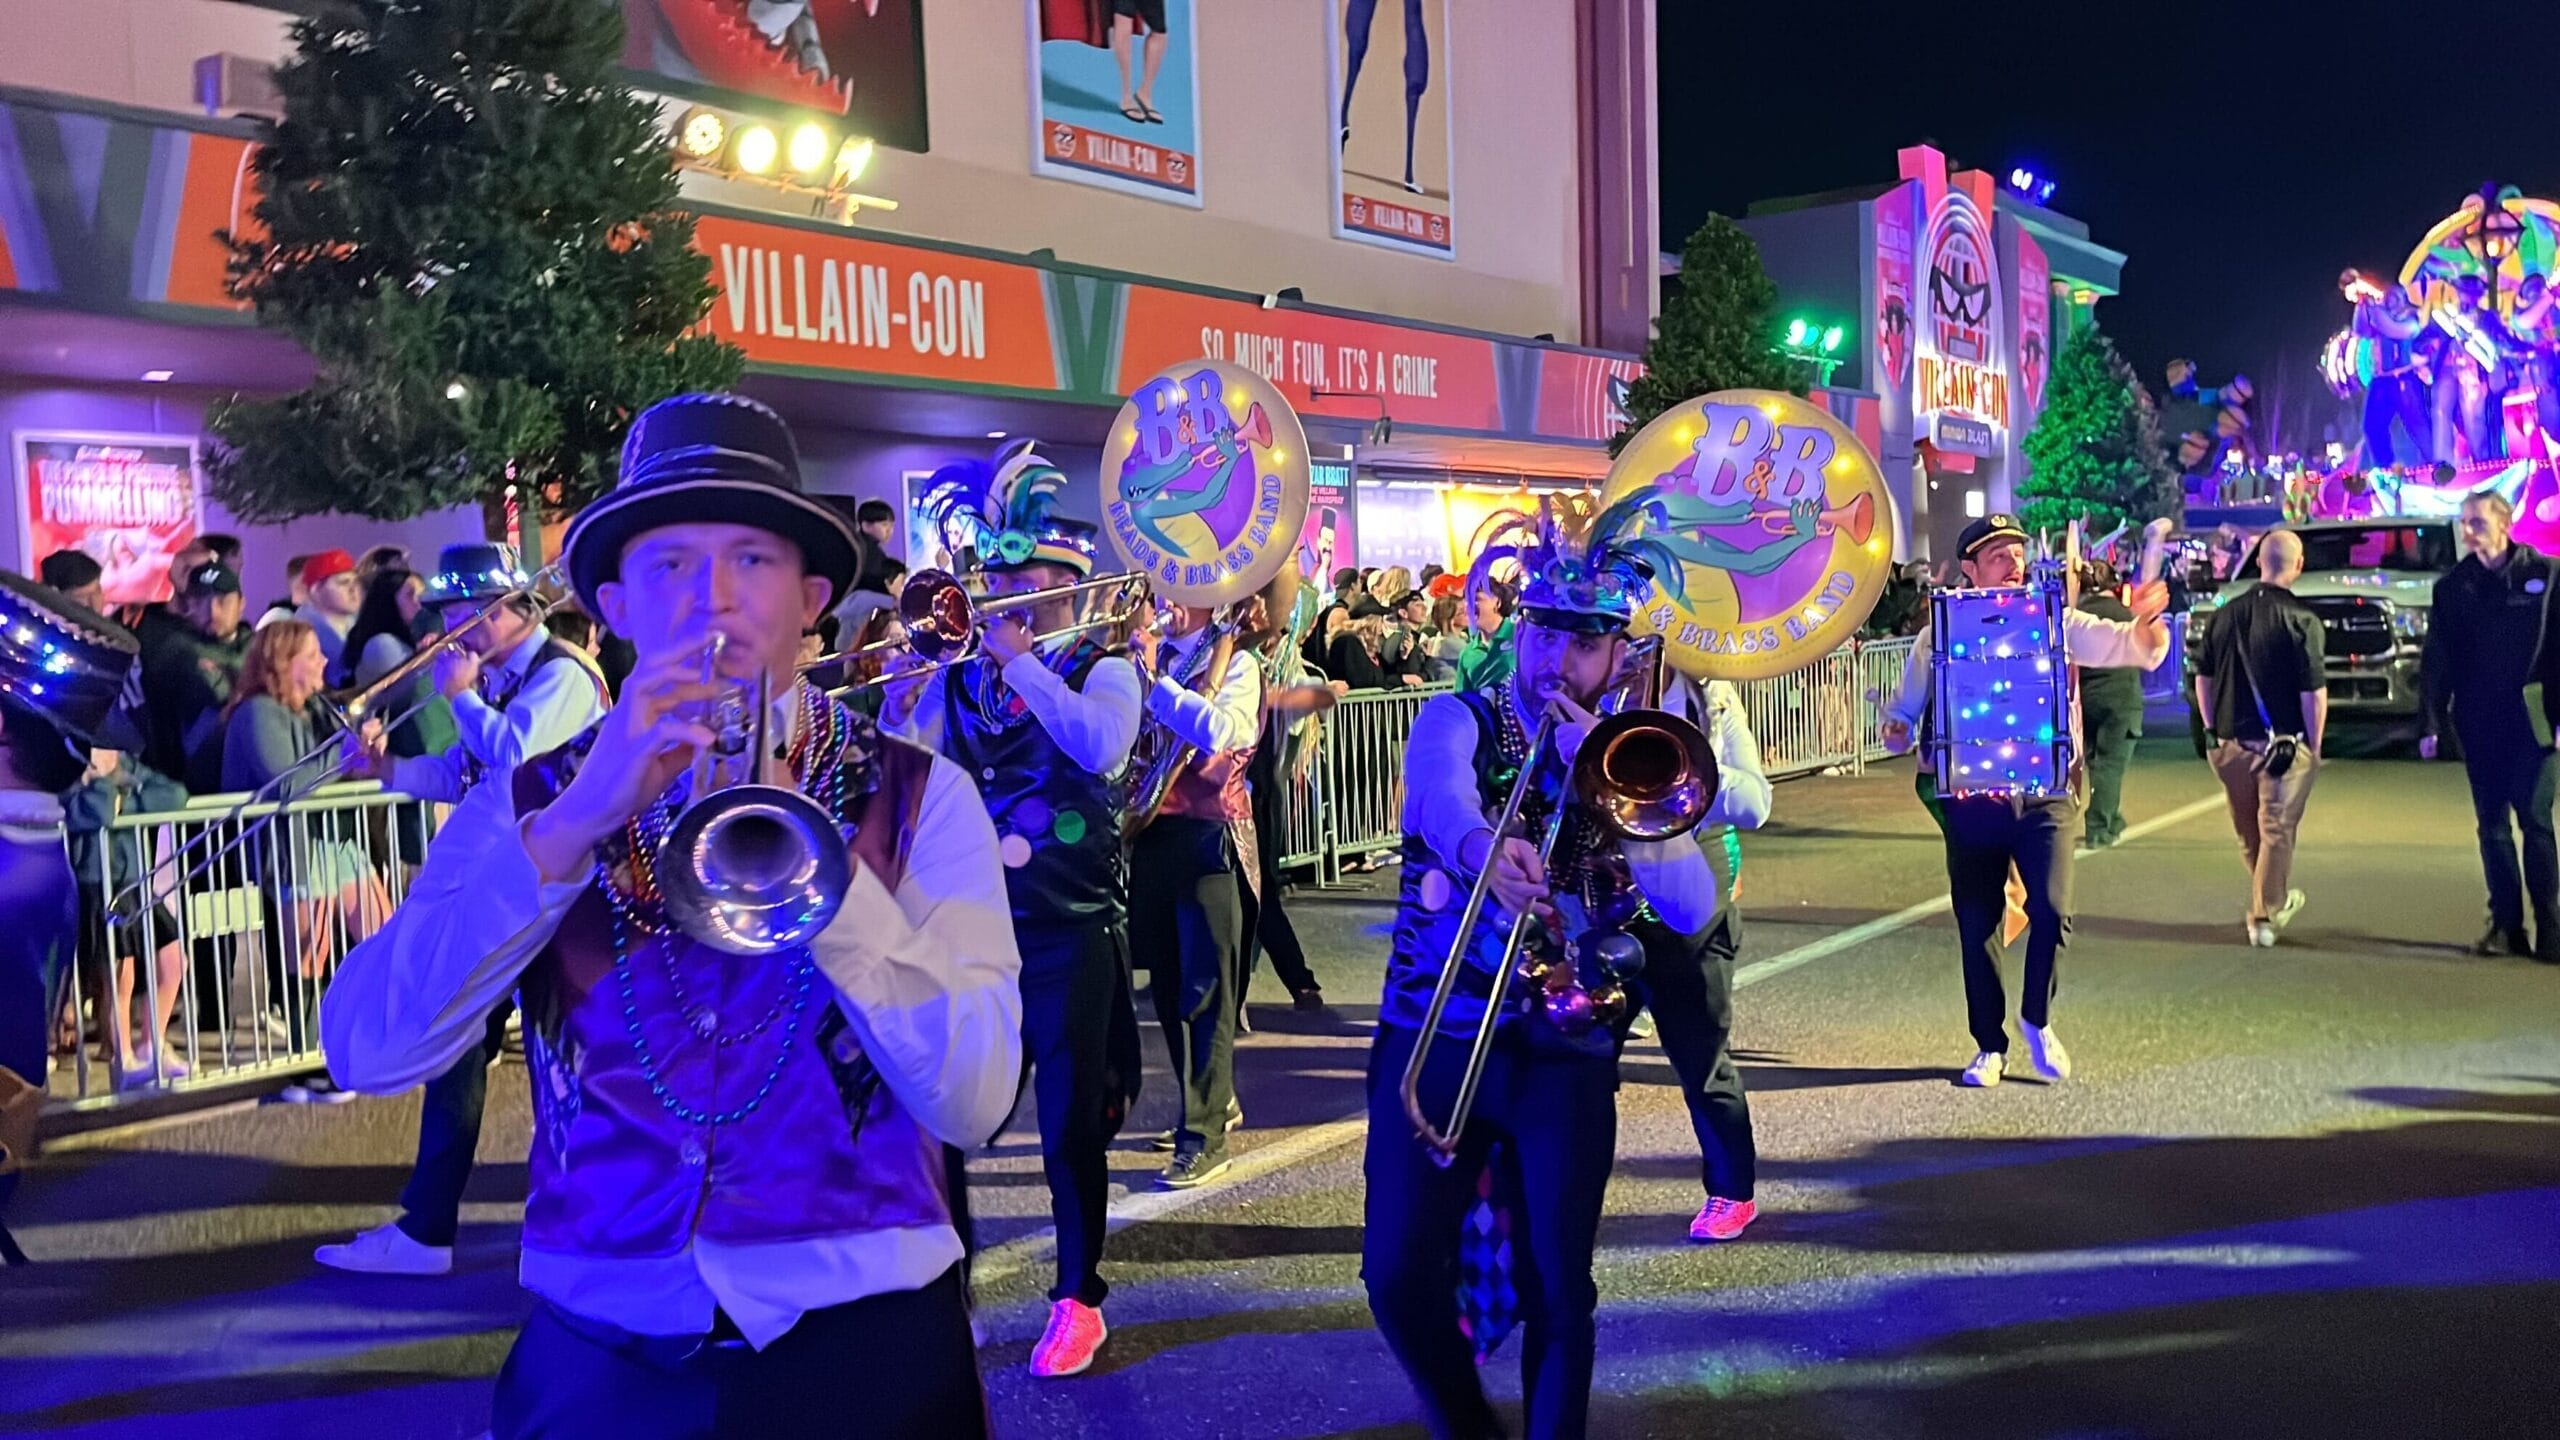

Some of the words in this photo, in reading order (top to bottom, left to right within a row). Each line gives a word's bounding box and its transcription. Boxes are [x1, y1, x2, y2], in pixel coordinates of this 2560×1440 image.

[720, 243, 985, 359] VILLAIN-CON
[1201, 326, 1224, 361] SO
[1234, 331, 1284, 382] MUCH
[1293, 340, 1331, 394] FUN,
[1338, 346, 1369, 391] IT'S
[1376, 351, 1386, 393] A
[1393, 353, 1438, 398] CRIME
[1130, 368, 1230, 465] B&B
[1693, 401, 1836, 507] B&B
[1108, 500, 1160, 570] BEADS
[1161, 558, 1178, 585] &
[1185, 544, 1254, 586] BRASS
[1250, 474, 1281, 547] BAND
[1650, 603, 1677, 631] &
[1679, 621, 1780, 656] BRASS
[1783, 571, 1856, 641] BAND
